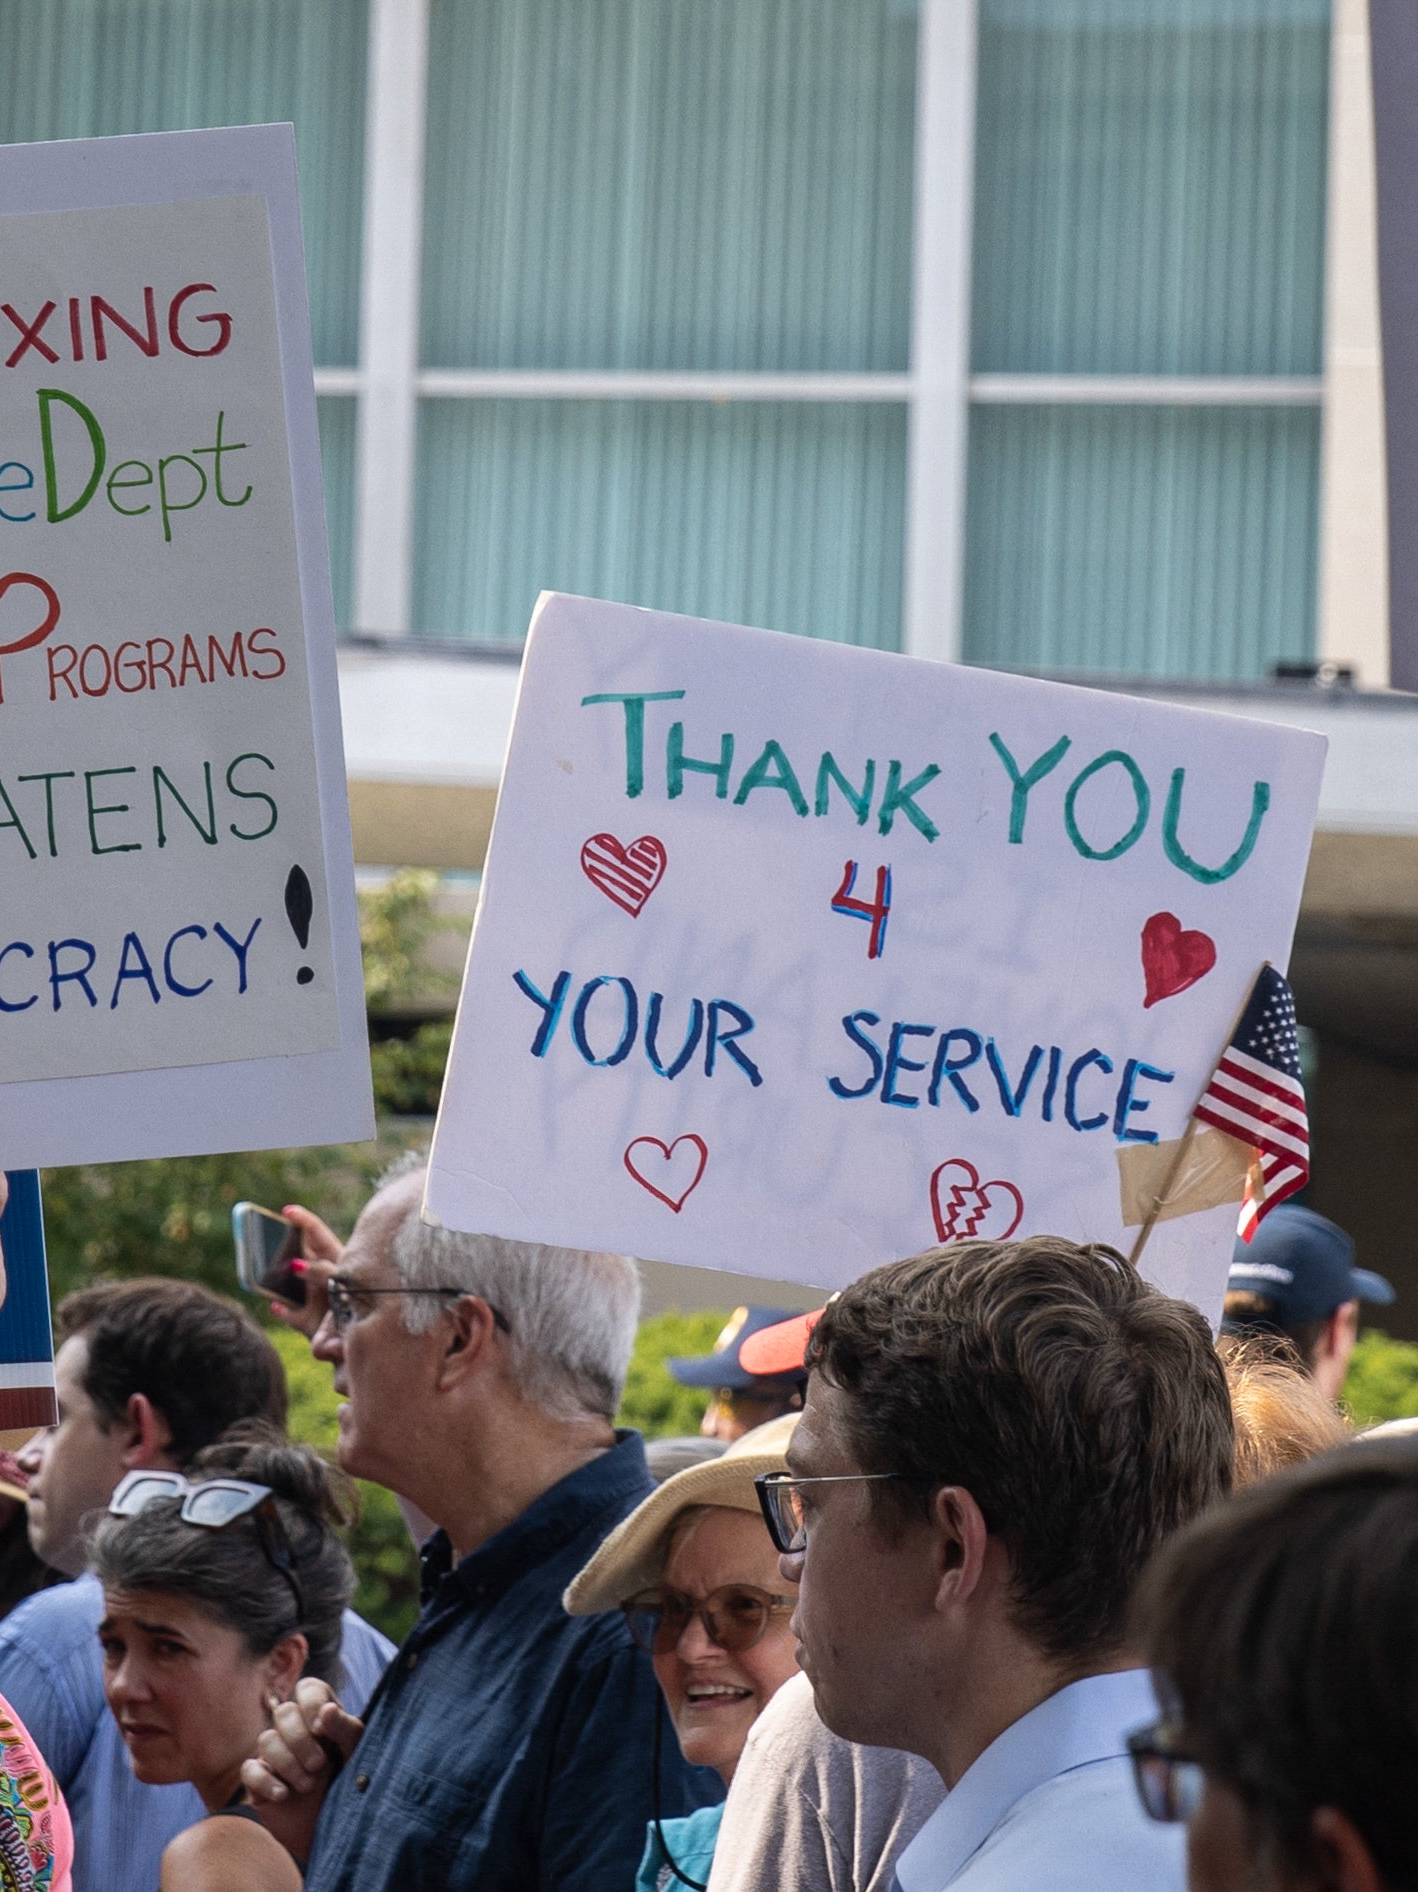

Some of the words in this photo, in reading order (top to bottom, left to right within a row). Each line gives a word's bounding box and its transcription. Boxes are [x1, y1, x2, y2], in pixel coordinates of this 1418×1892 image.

[582, 689, 941, 843] THANK
[989, 733, 1271, 885] YOU
[831, 860, 893, 959] 4
[512, 968, 764, 1087] YOUR
[826, 1010, 1175, 1144] SERVICE
